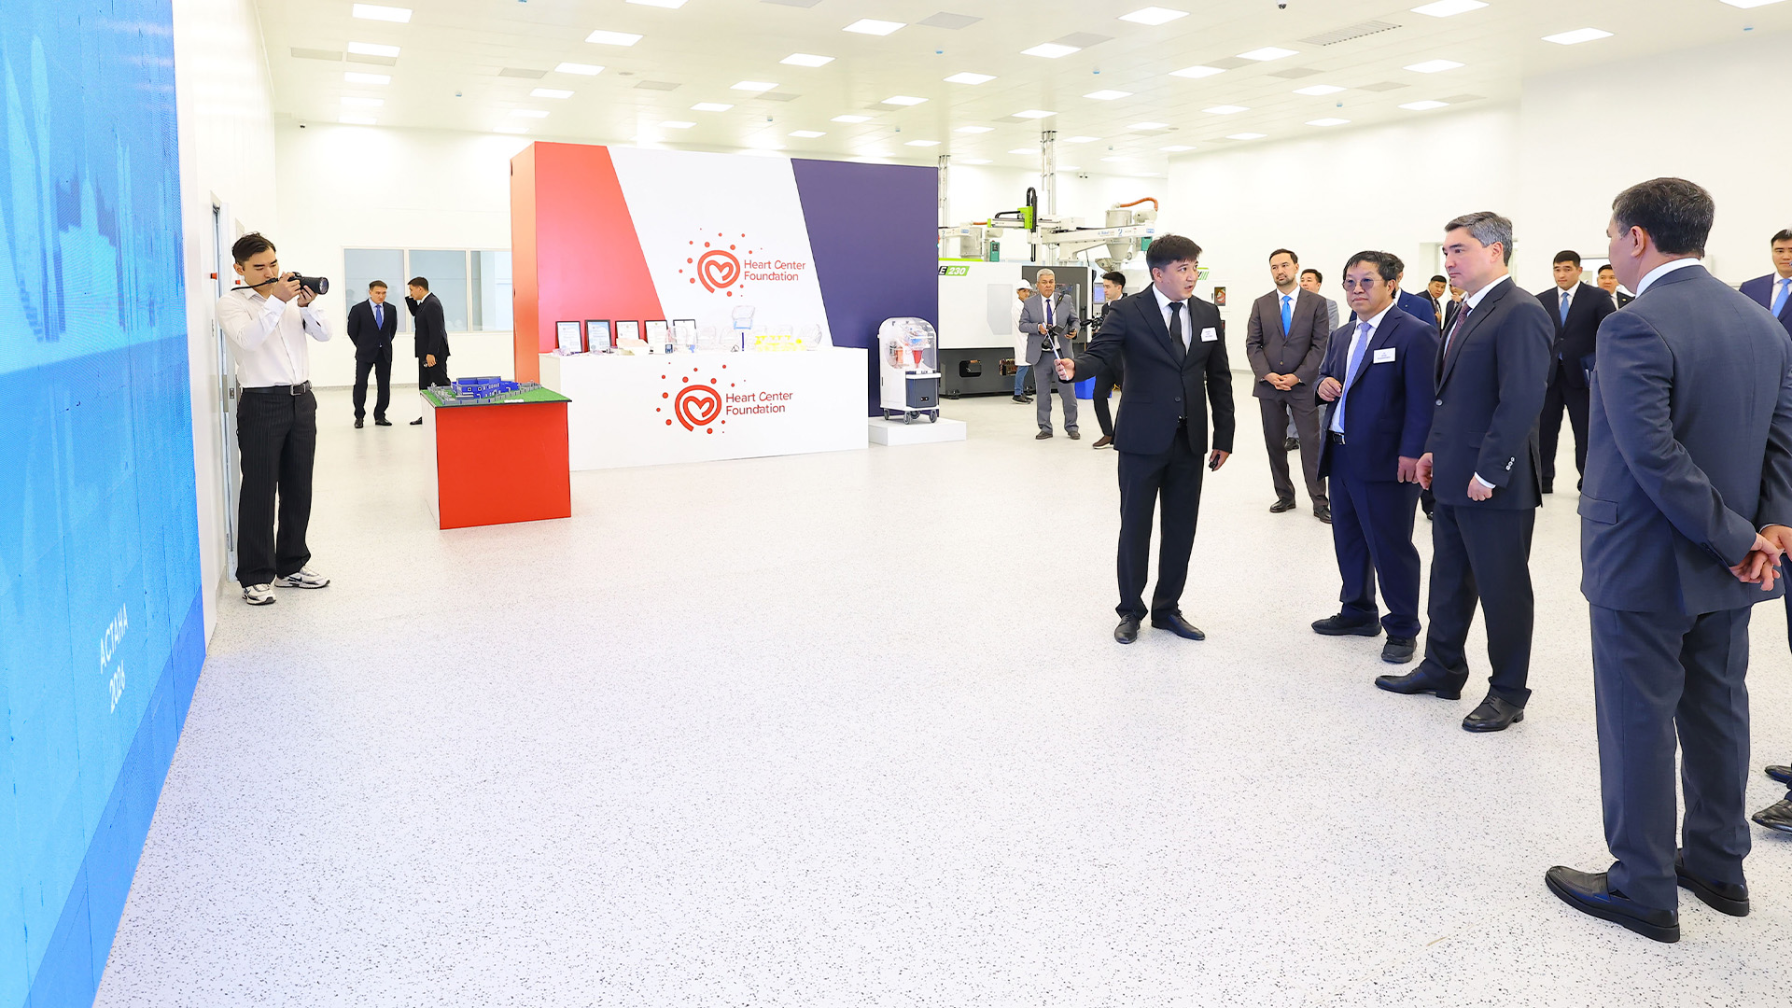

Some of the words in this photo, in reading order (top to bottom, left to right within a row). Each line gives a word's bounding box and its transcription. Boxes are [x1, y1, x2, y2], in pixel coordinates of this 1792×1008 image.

[744, 259, 771, 270] Heart
[774, 259, 806, 270] Center
[948, 266, 967, 275] 230
[744, 270, 799, 281] Foundation
[725, 392, 756, 403] Heart
[759, 391, 794, 402] Center
[726, 403, 786, 415] Foundation
[100, 602, 129, 675] АСТАНА
[109, 659, 126, 714] 2026
